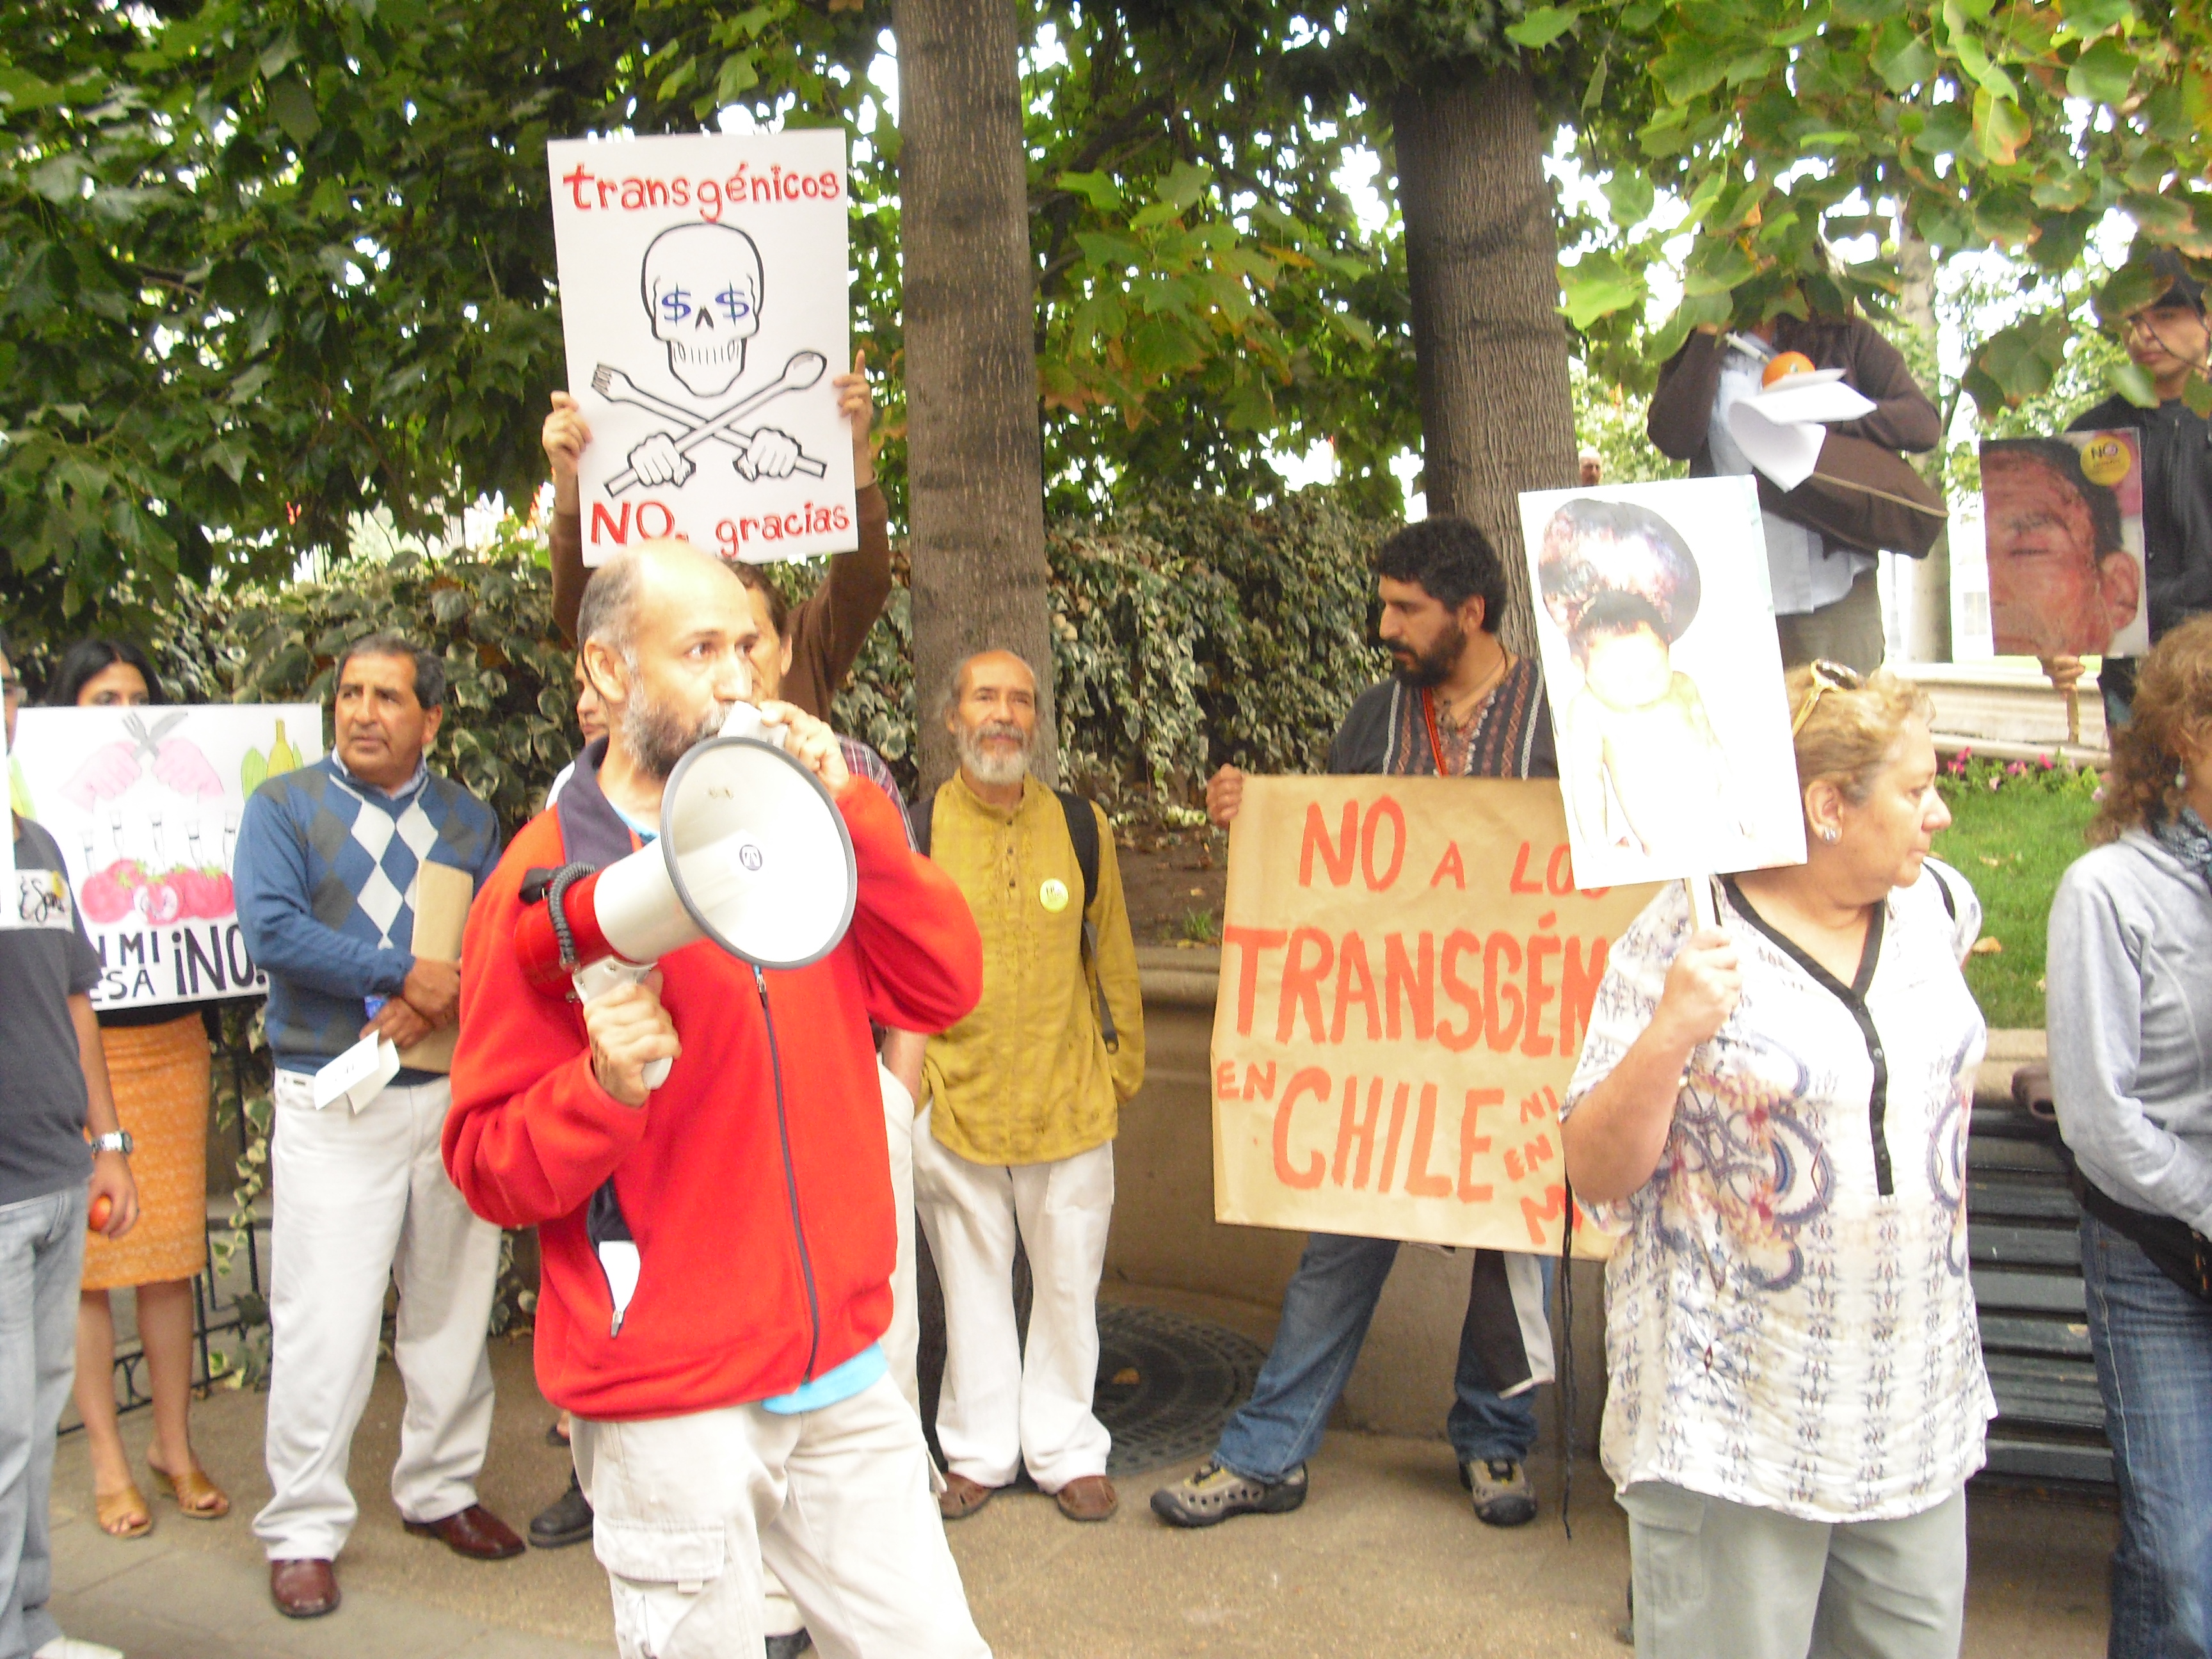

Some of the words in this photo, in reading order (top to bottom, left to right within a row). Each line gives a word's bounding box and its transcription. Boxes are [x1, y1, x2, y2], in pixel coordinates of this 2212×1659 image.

[563, 162, 840, 223] transgénicos
[715, 501, 851, 557] gracias
[1298, 794, 1407, 891] NO
[1430, 840, 1466, 890] A
[1509, 840, 1611, 899] LO
[119, 930, 160, 966] MI
[1215, 1060, 1276, 1102] EN
[1273, 1066, 1505, 1203] CHILE
[1519, 1085, 1559, 1124] NI
[1503, 1132, 1554, 1182] EN
